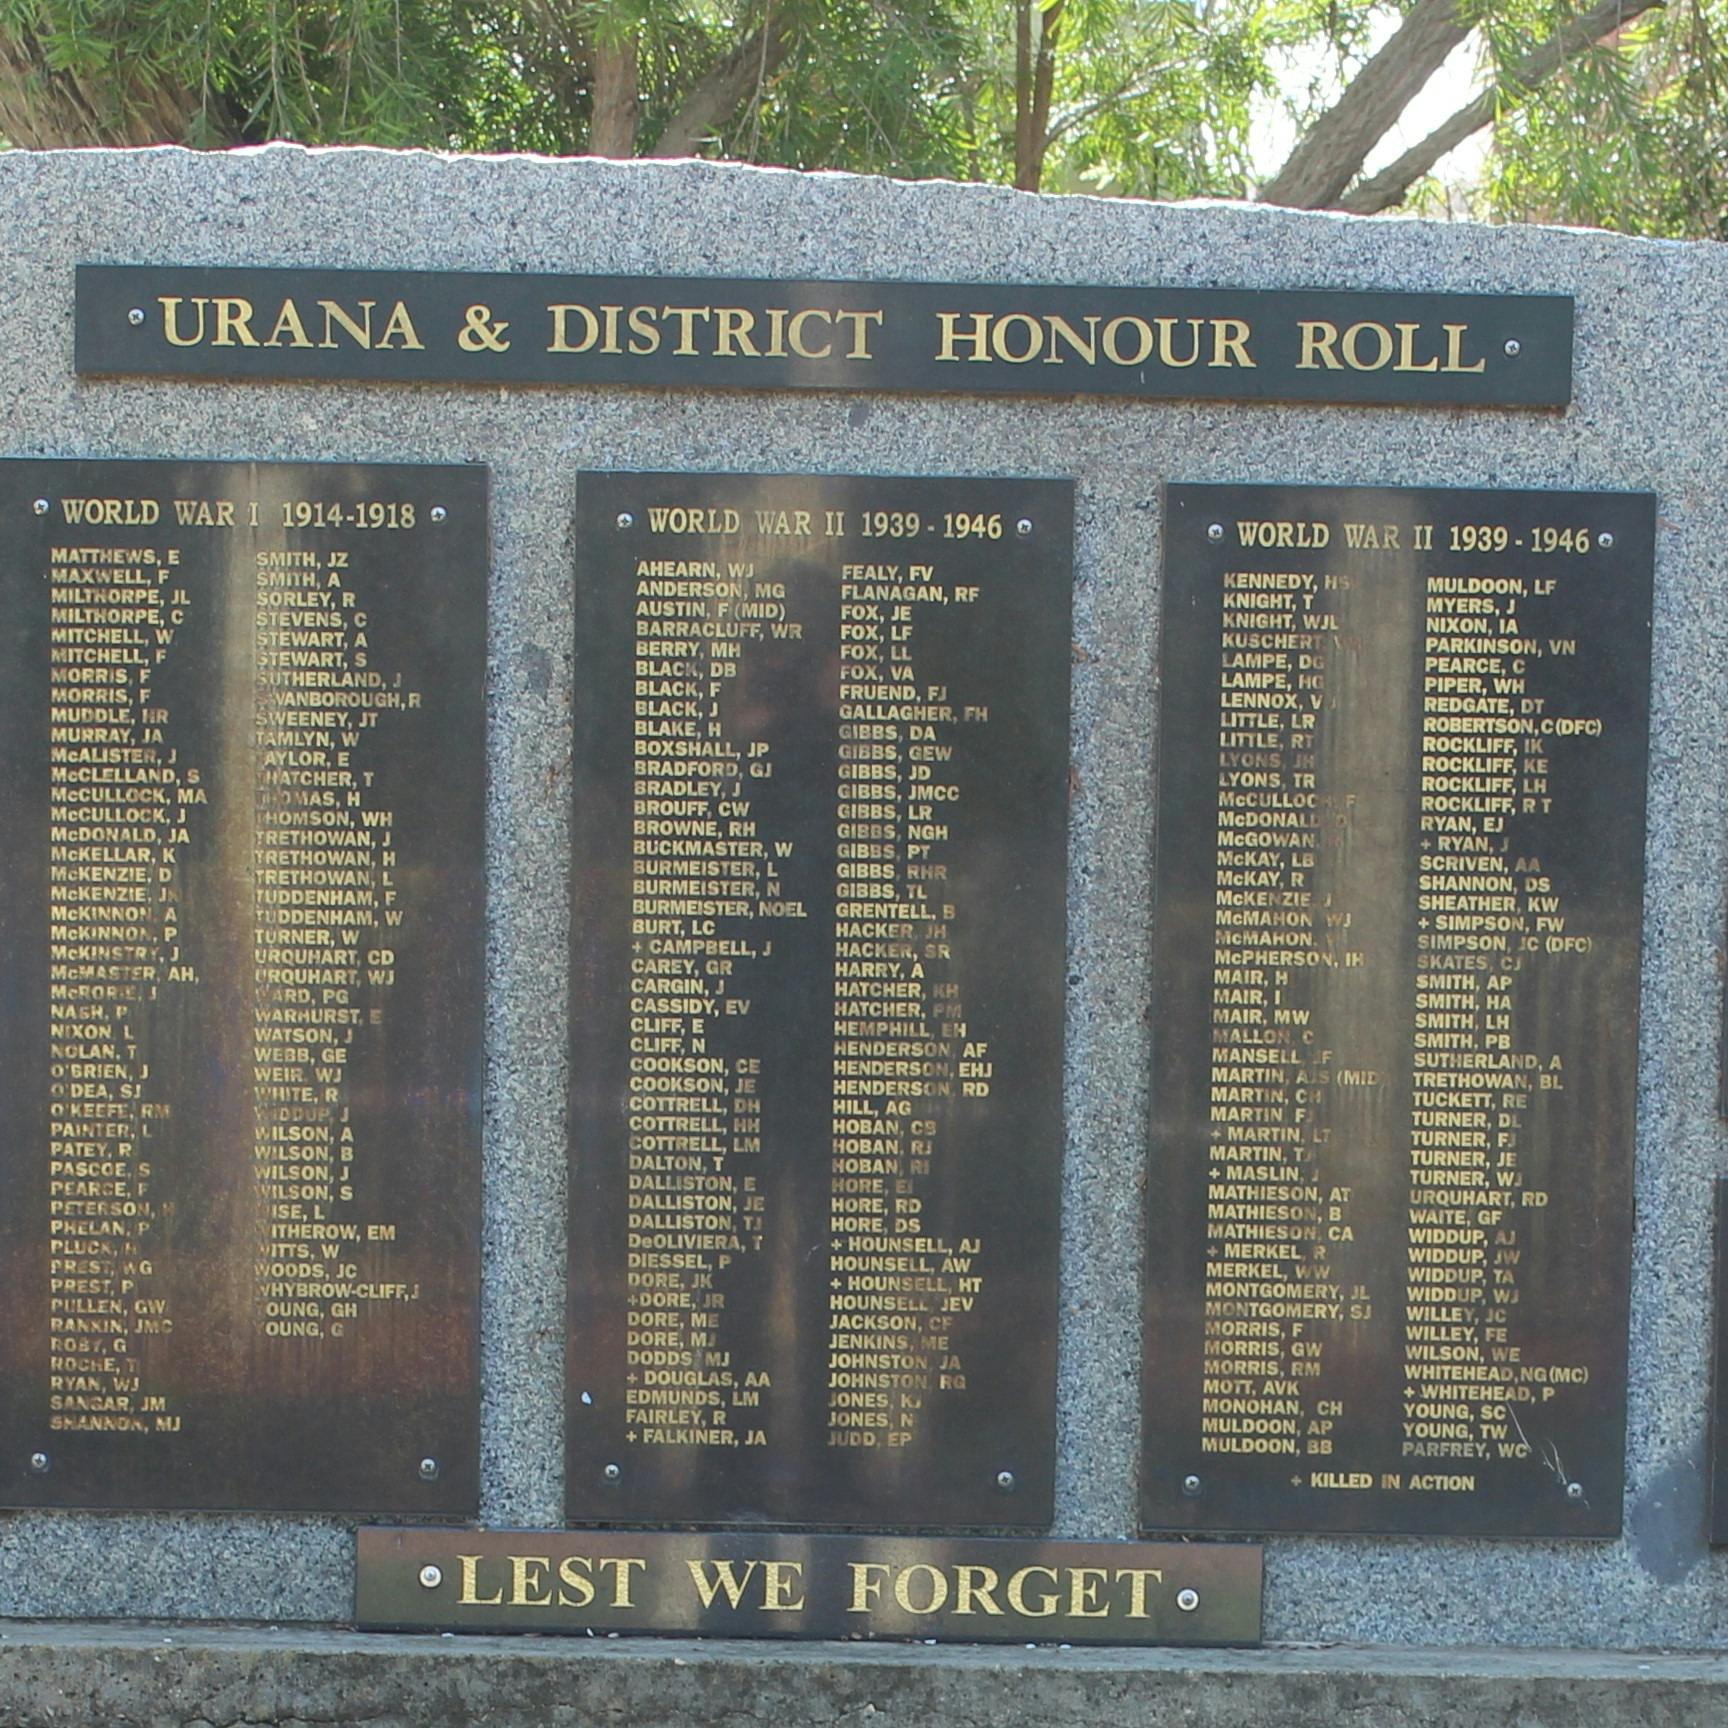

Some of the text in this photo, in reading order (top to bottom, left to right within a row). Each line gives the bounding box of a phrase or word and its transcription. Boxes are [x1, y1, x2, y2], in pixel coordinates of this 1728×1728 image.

[158, 297, 1485, 372] URANA & DISTRICT HONOUR ROLL
[62, 499, 416, 528] WORLD WAR I 1914-1918
[648, 508, 740, 534] WORLD
[758, 511, 811, 535] WAR
[825, 511, 844, 536] II
[863, 512, 920, 537] 1939
[945, 514, 1002, 539] 1946
[1237, 522, 1329, 547] WORLD
[1344, 524, 1400, 549] WAR
[1413, 525, 1433, 549] II
[1450, 526, 1508, 551] 1939
[1532, 528, 1589, 553] 1946
[52, 548, 179, 567] MATTHEWS, E
[256, 552, 348, 570] SMITH, JZ
[637, 562, 753, 581] AHEARN, WJ
[842, 564, 933, 583] FEALY, FV
[1427, 578, 1556, 598] MULDOON, LF
[1224, 593, 1313, 612] KNIGHT, T
[256, 612, 366, 630] STEVENS, C
[841, 606, 911, 626] FOX, JE
[52, 628, 173, 646] MITCHELL, W
[636, 681, 721, 699] BLACK, F
[1425, 677, 1524, 695] PIPER, WH
[1221, 713, 1315, 731] LITTLE, LR
[177, 809, 185, 823] J
[838, 804, 932, 822] GIBBS, LR
[634, 820, 755, 838] BROWNE, RH
[52, 847, 175, 865] McKELLAR, K
[1217, 871, 1304, 889] McKAY, R
[1419, 875, 1550, 894] SHANNON, DS
[255, 929, 359, 948] TURNER, W
[1416, 975, 1512, 992] SMITH, AP
[631, 1018, 704, 1036] CLIFF, E
[1214, 1009, 1309, 1027] MAIR, MW
[255, 1048, 346, 1067] WEBB, GE
[833, 1100, 911, 1118] HILL, AG
[341, 1147, 353, 1161] B
[832, 1198, 921, 1216] HORE, RD
[51, 1376, 139, 1394] RYAN, WJ
[1204, 1379, 1299, 1397] MOTT, AVK
[626, 1391, 759, 1410] EDMUNDS, LM
[1404, 1403, 1506, 1421] YOUNG, SC
[1311, 1473, 1372, 1488] KILLED
[1382, 1475, 1400, 1488] IN
[1409, 1475, 1474, 1490] ACTION
[458, 1556, 1162, 1620] LEST WE FORGET
